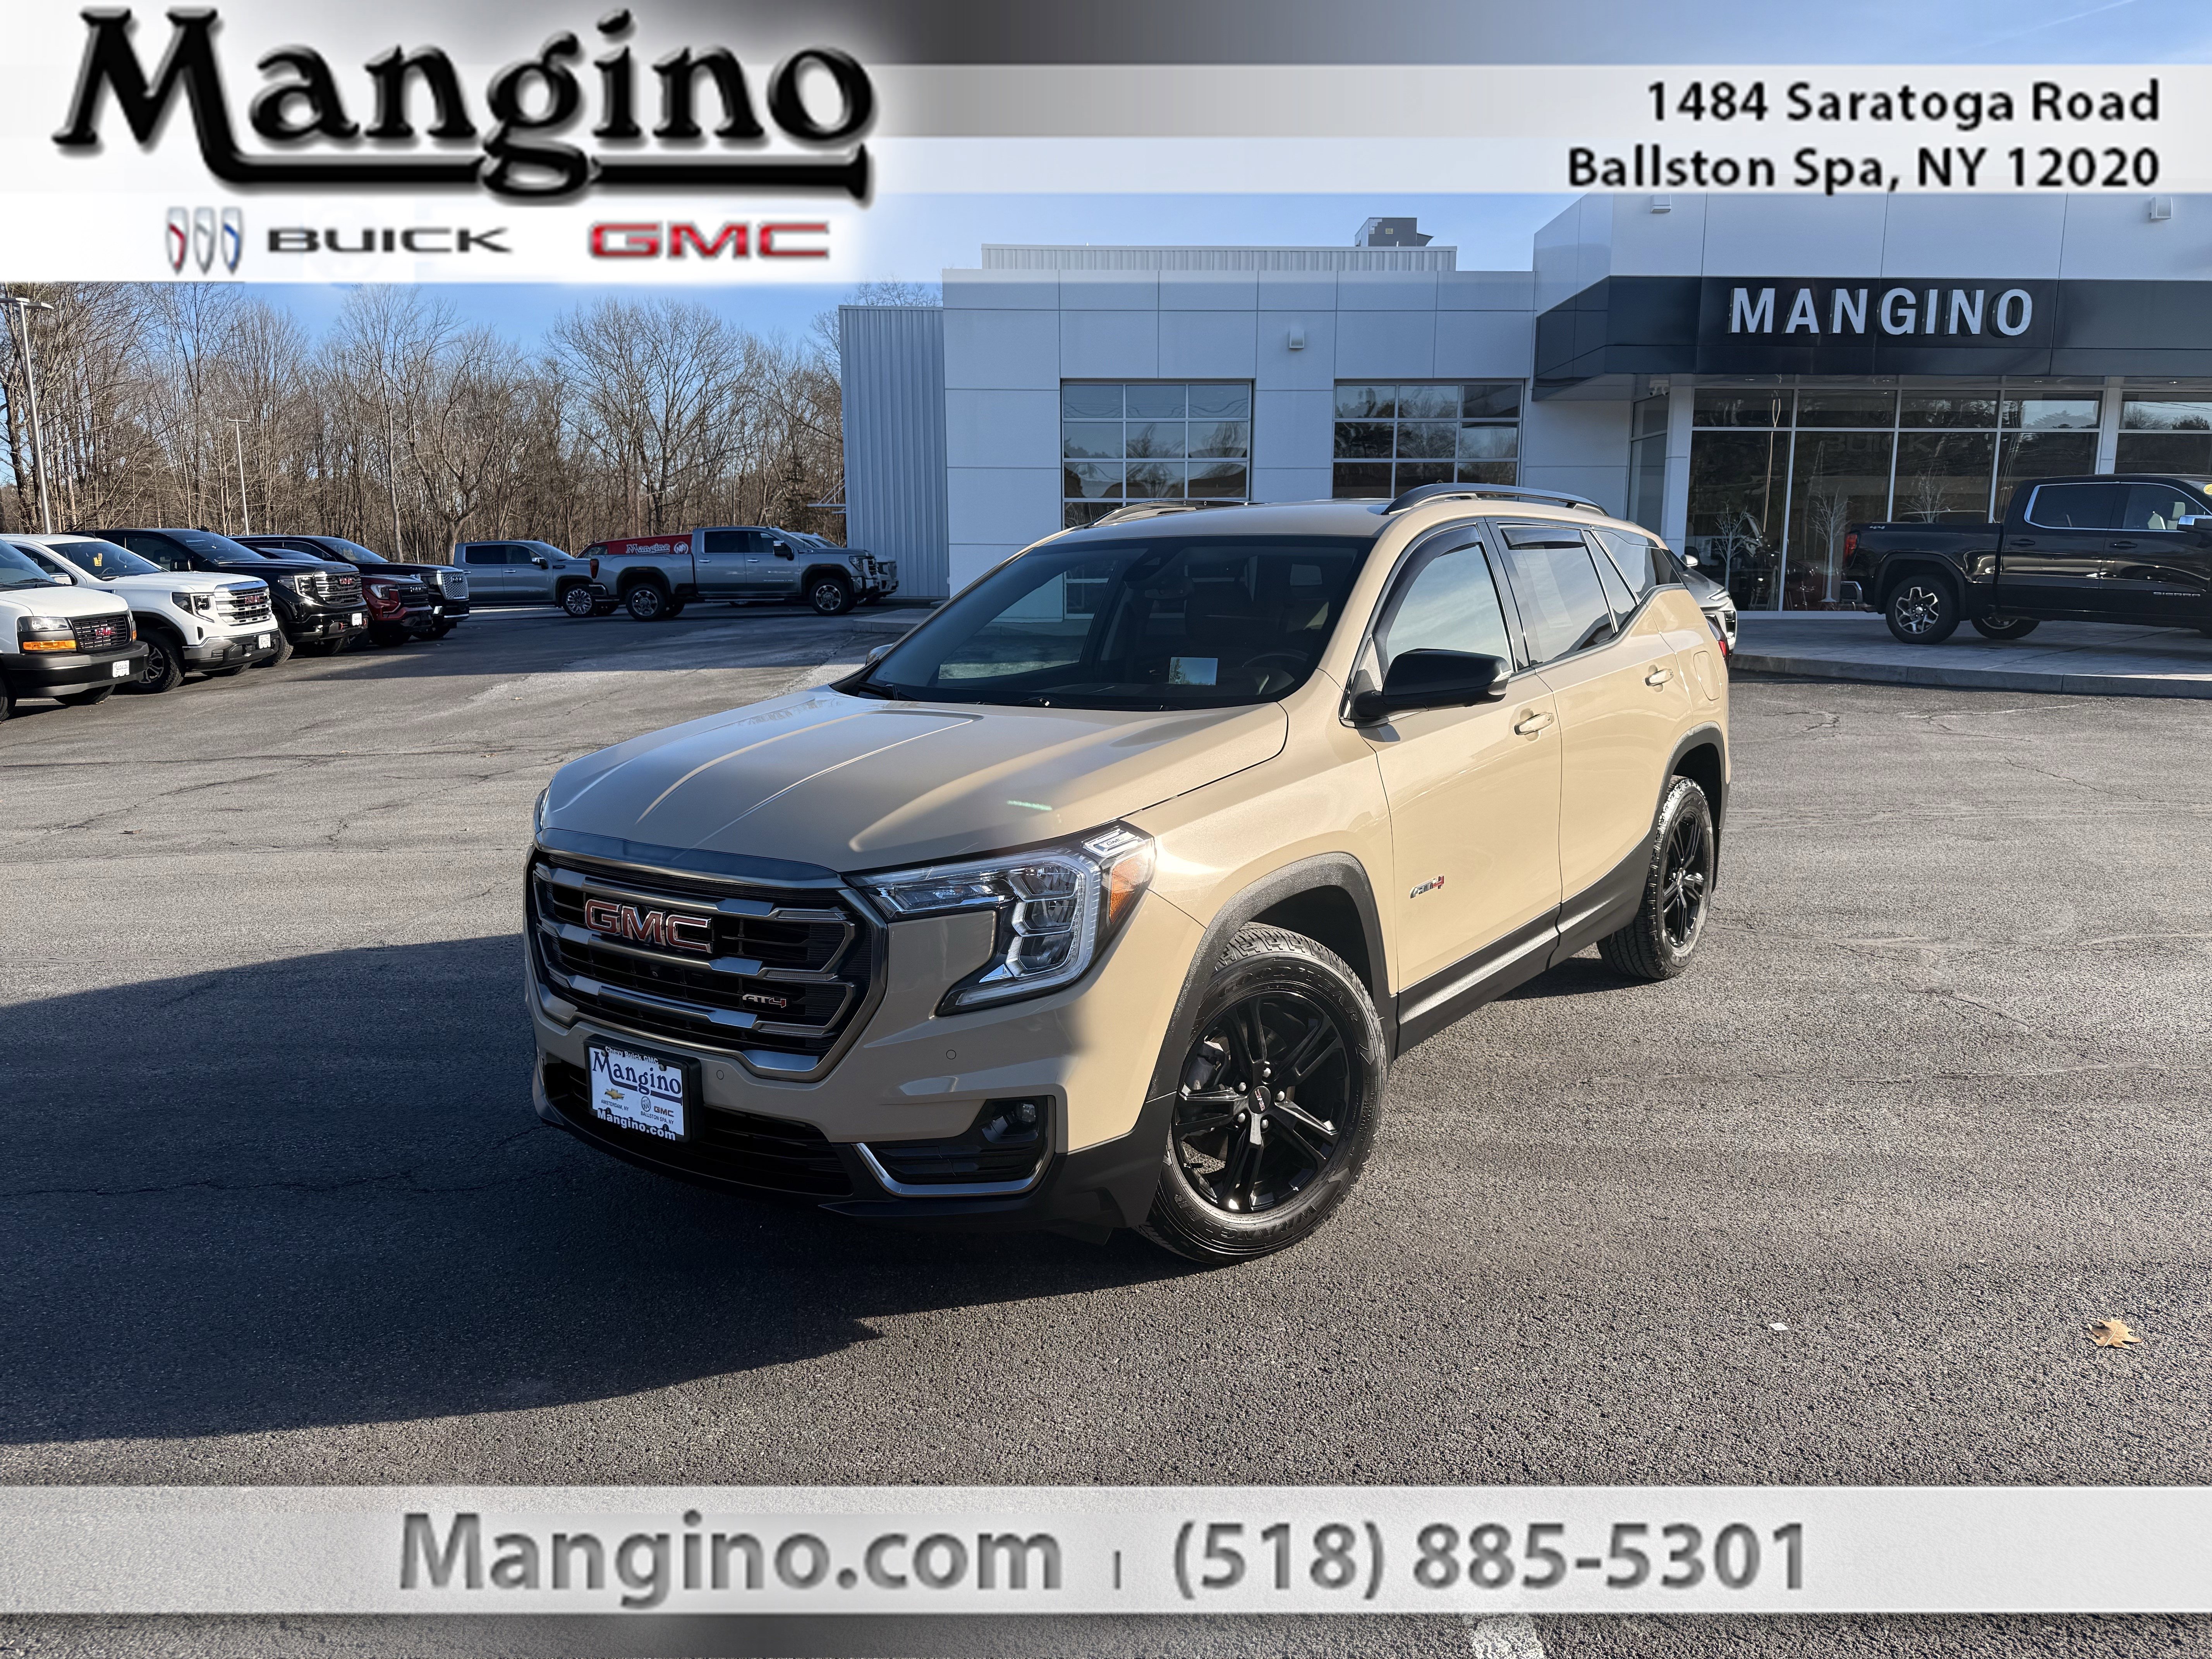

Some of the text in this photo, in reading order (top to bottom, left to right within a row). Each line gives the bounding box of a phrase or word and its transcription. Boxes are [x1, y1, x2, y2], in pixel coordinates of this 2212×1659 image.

[1730, 287, 2033, 336] MANGINO
[584, 898, 713, 954] GMC
[742, 993, 787, 1008] AT4
[605, 1046, 659, 1064] Chevy Buick GMC
[592, 1051, 683, 1106] Mangino
[641, 1111, 659, 1120] BALLSTON
[654, 1106, 675, 1117] GMC
[597, 1109, 676, 1141] Mangino.com
